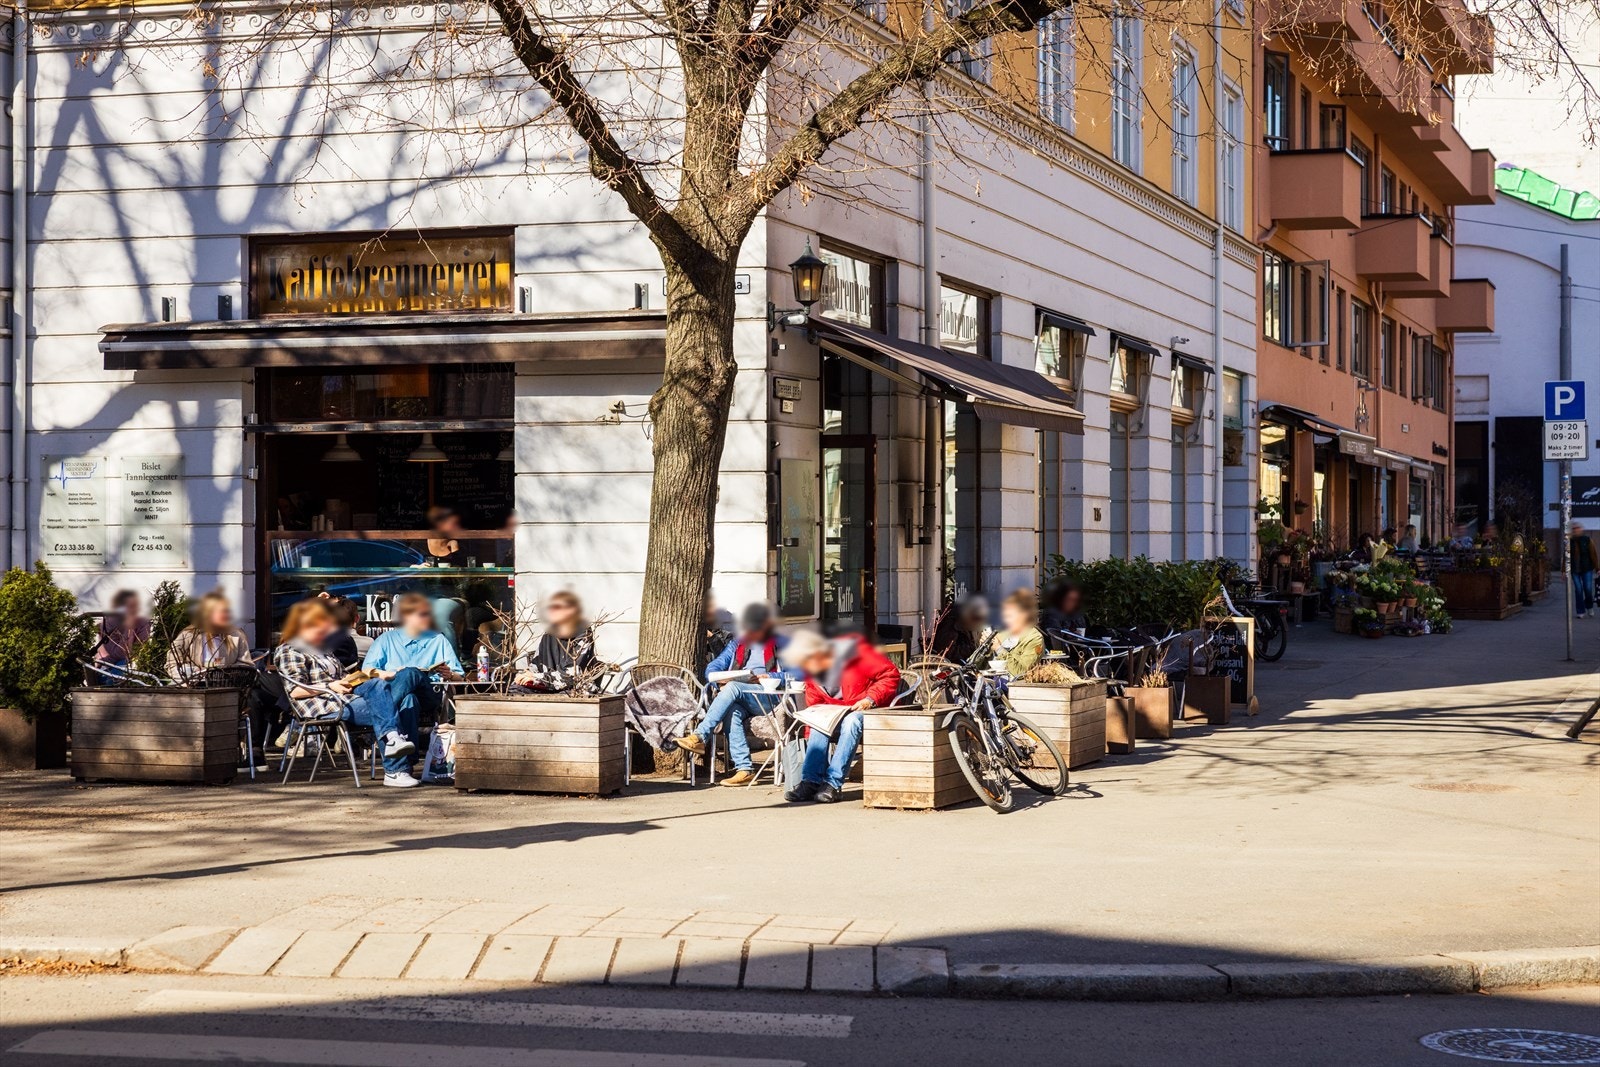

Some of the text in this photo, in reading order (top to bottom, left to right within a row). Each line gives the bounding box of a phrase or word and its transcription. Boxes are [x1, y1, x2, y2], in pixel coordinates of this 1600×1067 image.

[267, 249, 498, 300] Kaffebrenneriet
[1554, 386, 1576, 416] P
[141, 462, 161, 470] Bislet
[125, 473, 179, 483] Tannlegesenter
[837, 586, 853, 613] Kaffe
[1220, 645, 1230, 660] og
[1213, 656, 1244, 669] roissant
